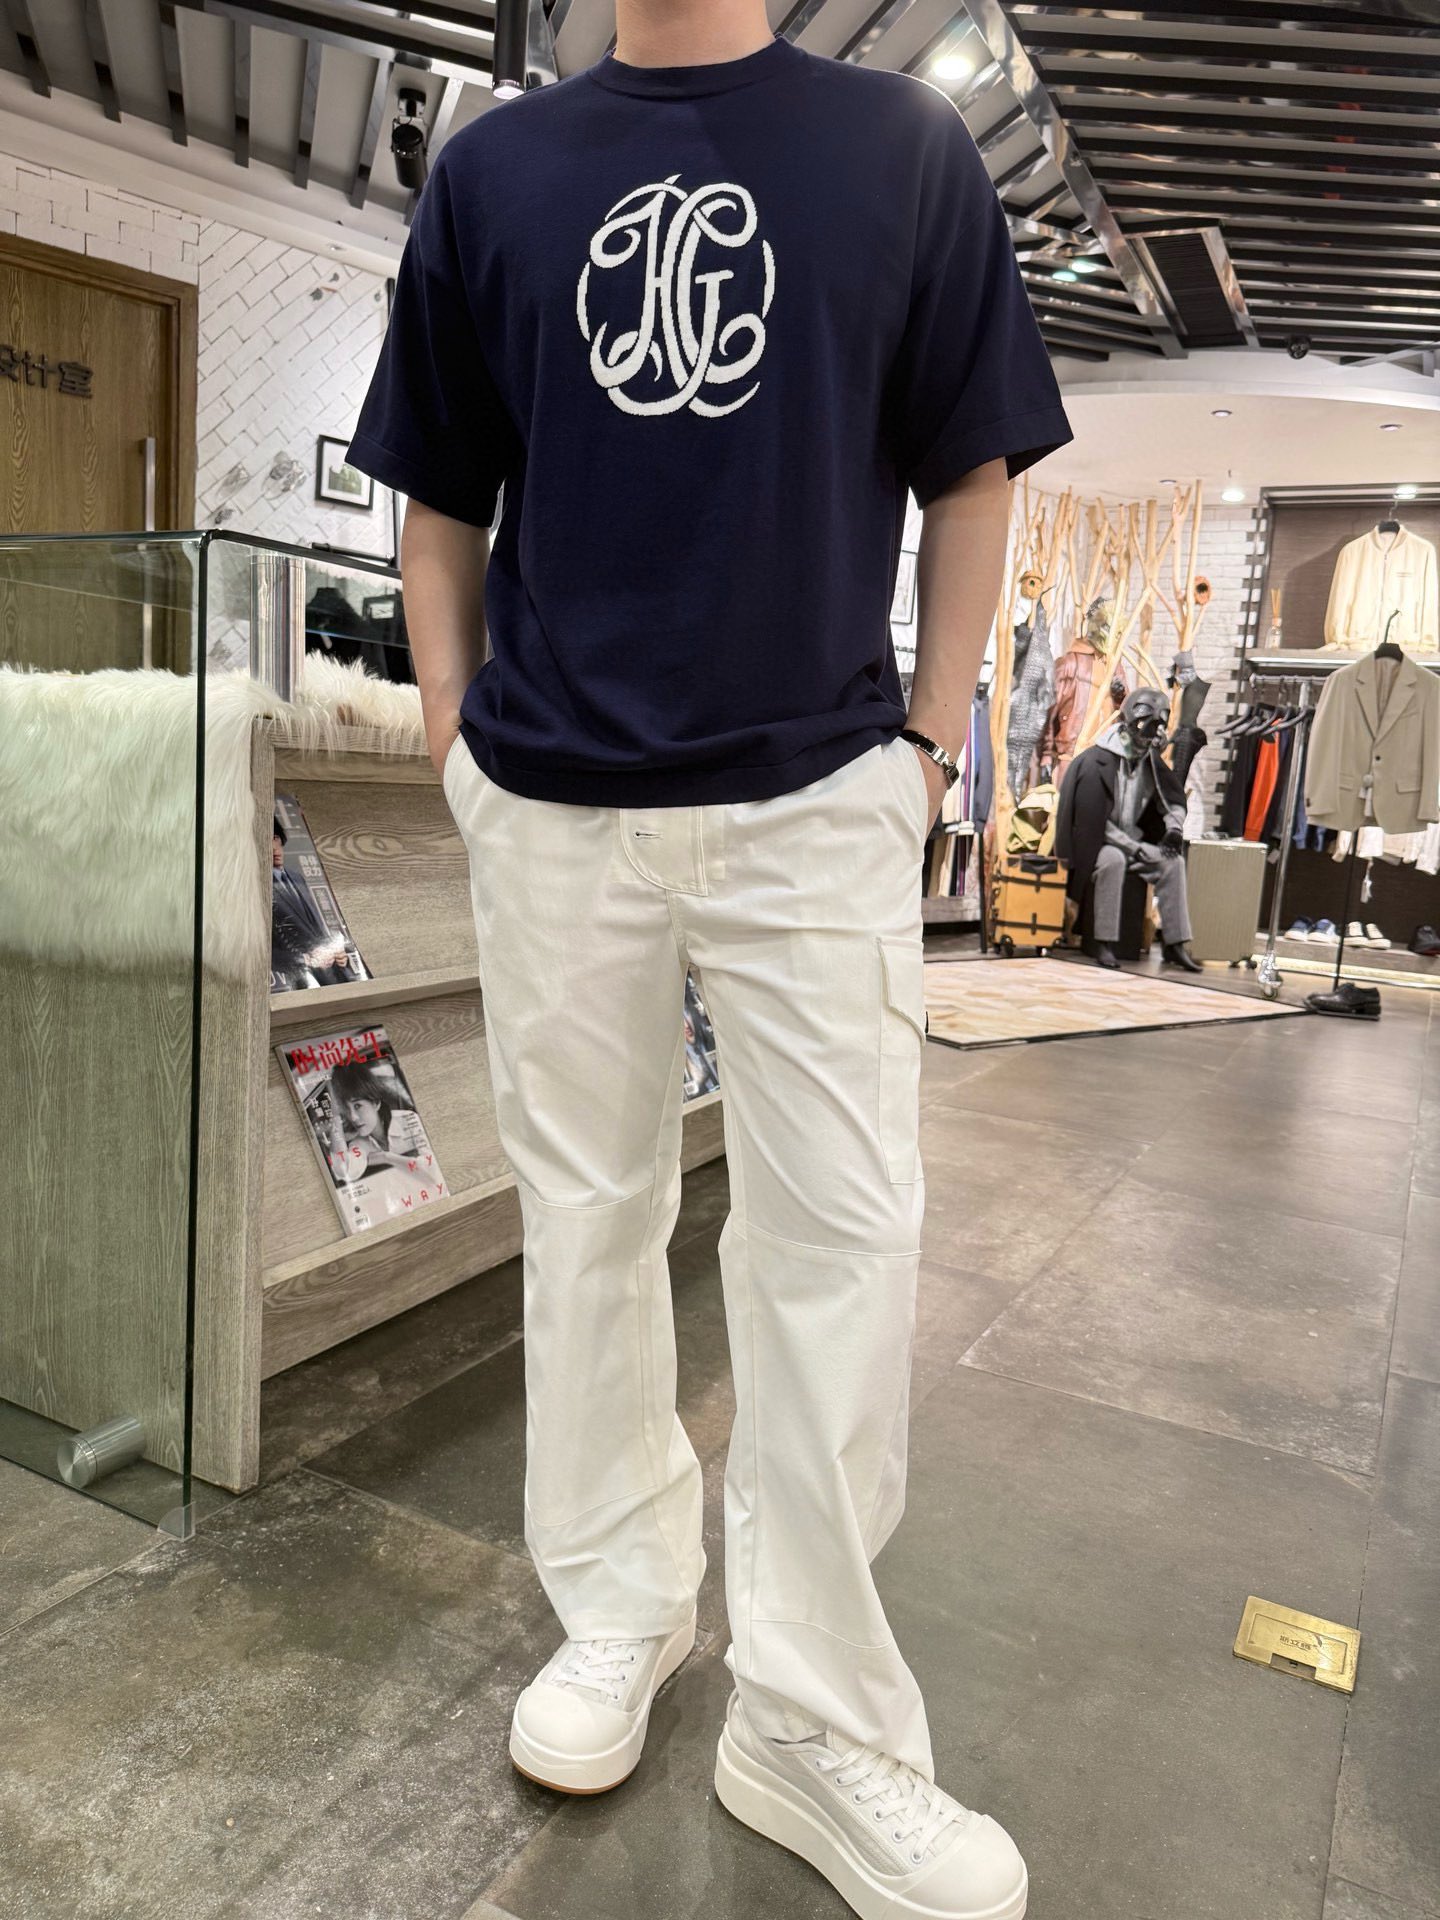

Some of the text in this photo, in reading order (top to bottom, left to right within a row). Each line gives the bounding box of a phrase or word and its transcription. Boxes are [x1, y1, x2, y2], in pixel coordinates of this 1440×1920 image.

[290, 1030, 391, 1077] 时尚先生
[399, 1183, 445, 1208] WAY
